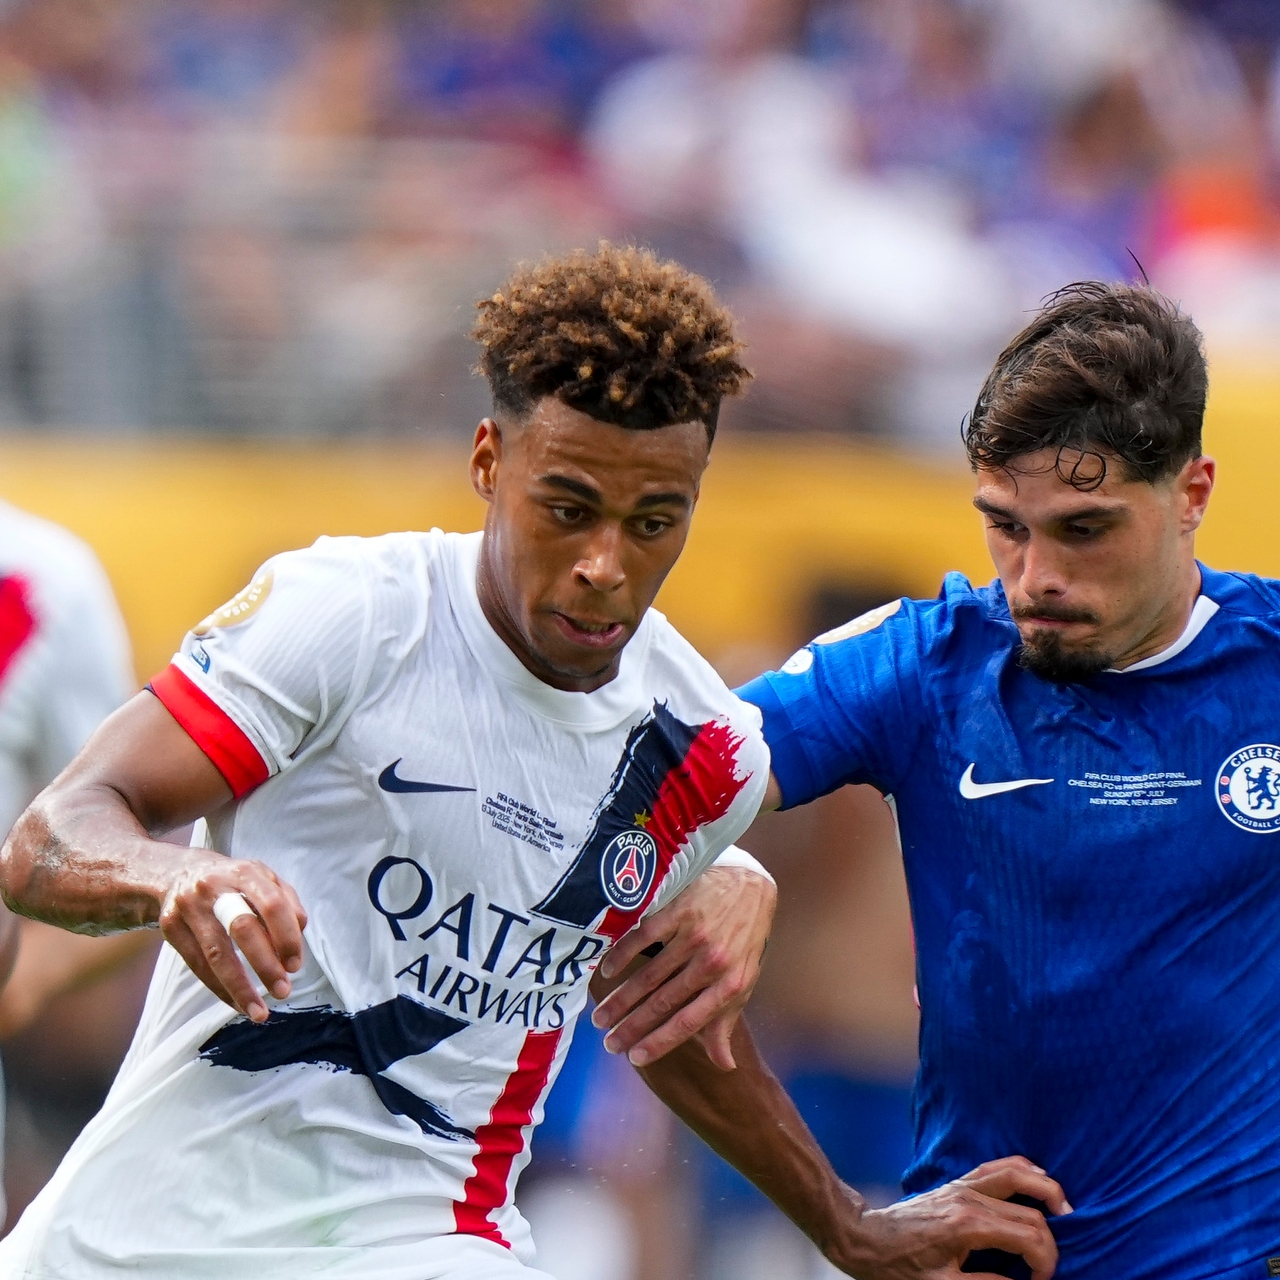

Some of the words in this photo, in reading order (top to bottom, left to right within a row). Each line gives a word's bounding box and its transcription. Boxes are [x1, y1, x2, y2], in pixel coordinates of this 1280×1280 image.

[1067, 779, 1103, 789] CHELSEA
[1148, 772, 1165, 780] CUP
[1146, 790, 1166, 798] JULY
[1232, 812, 1272, 828] FOOTBALL
[616, 833, 653, 857] PARIS
[367, 855, 605, 987] QATAR
[395, 953, 569, 1029] AIRWAYS
